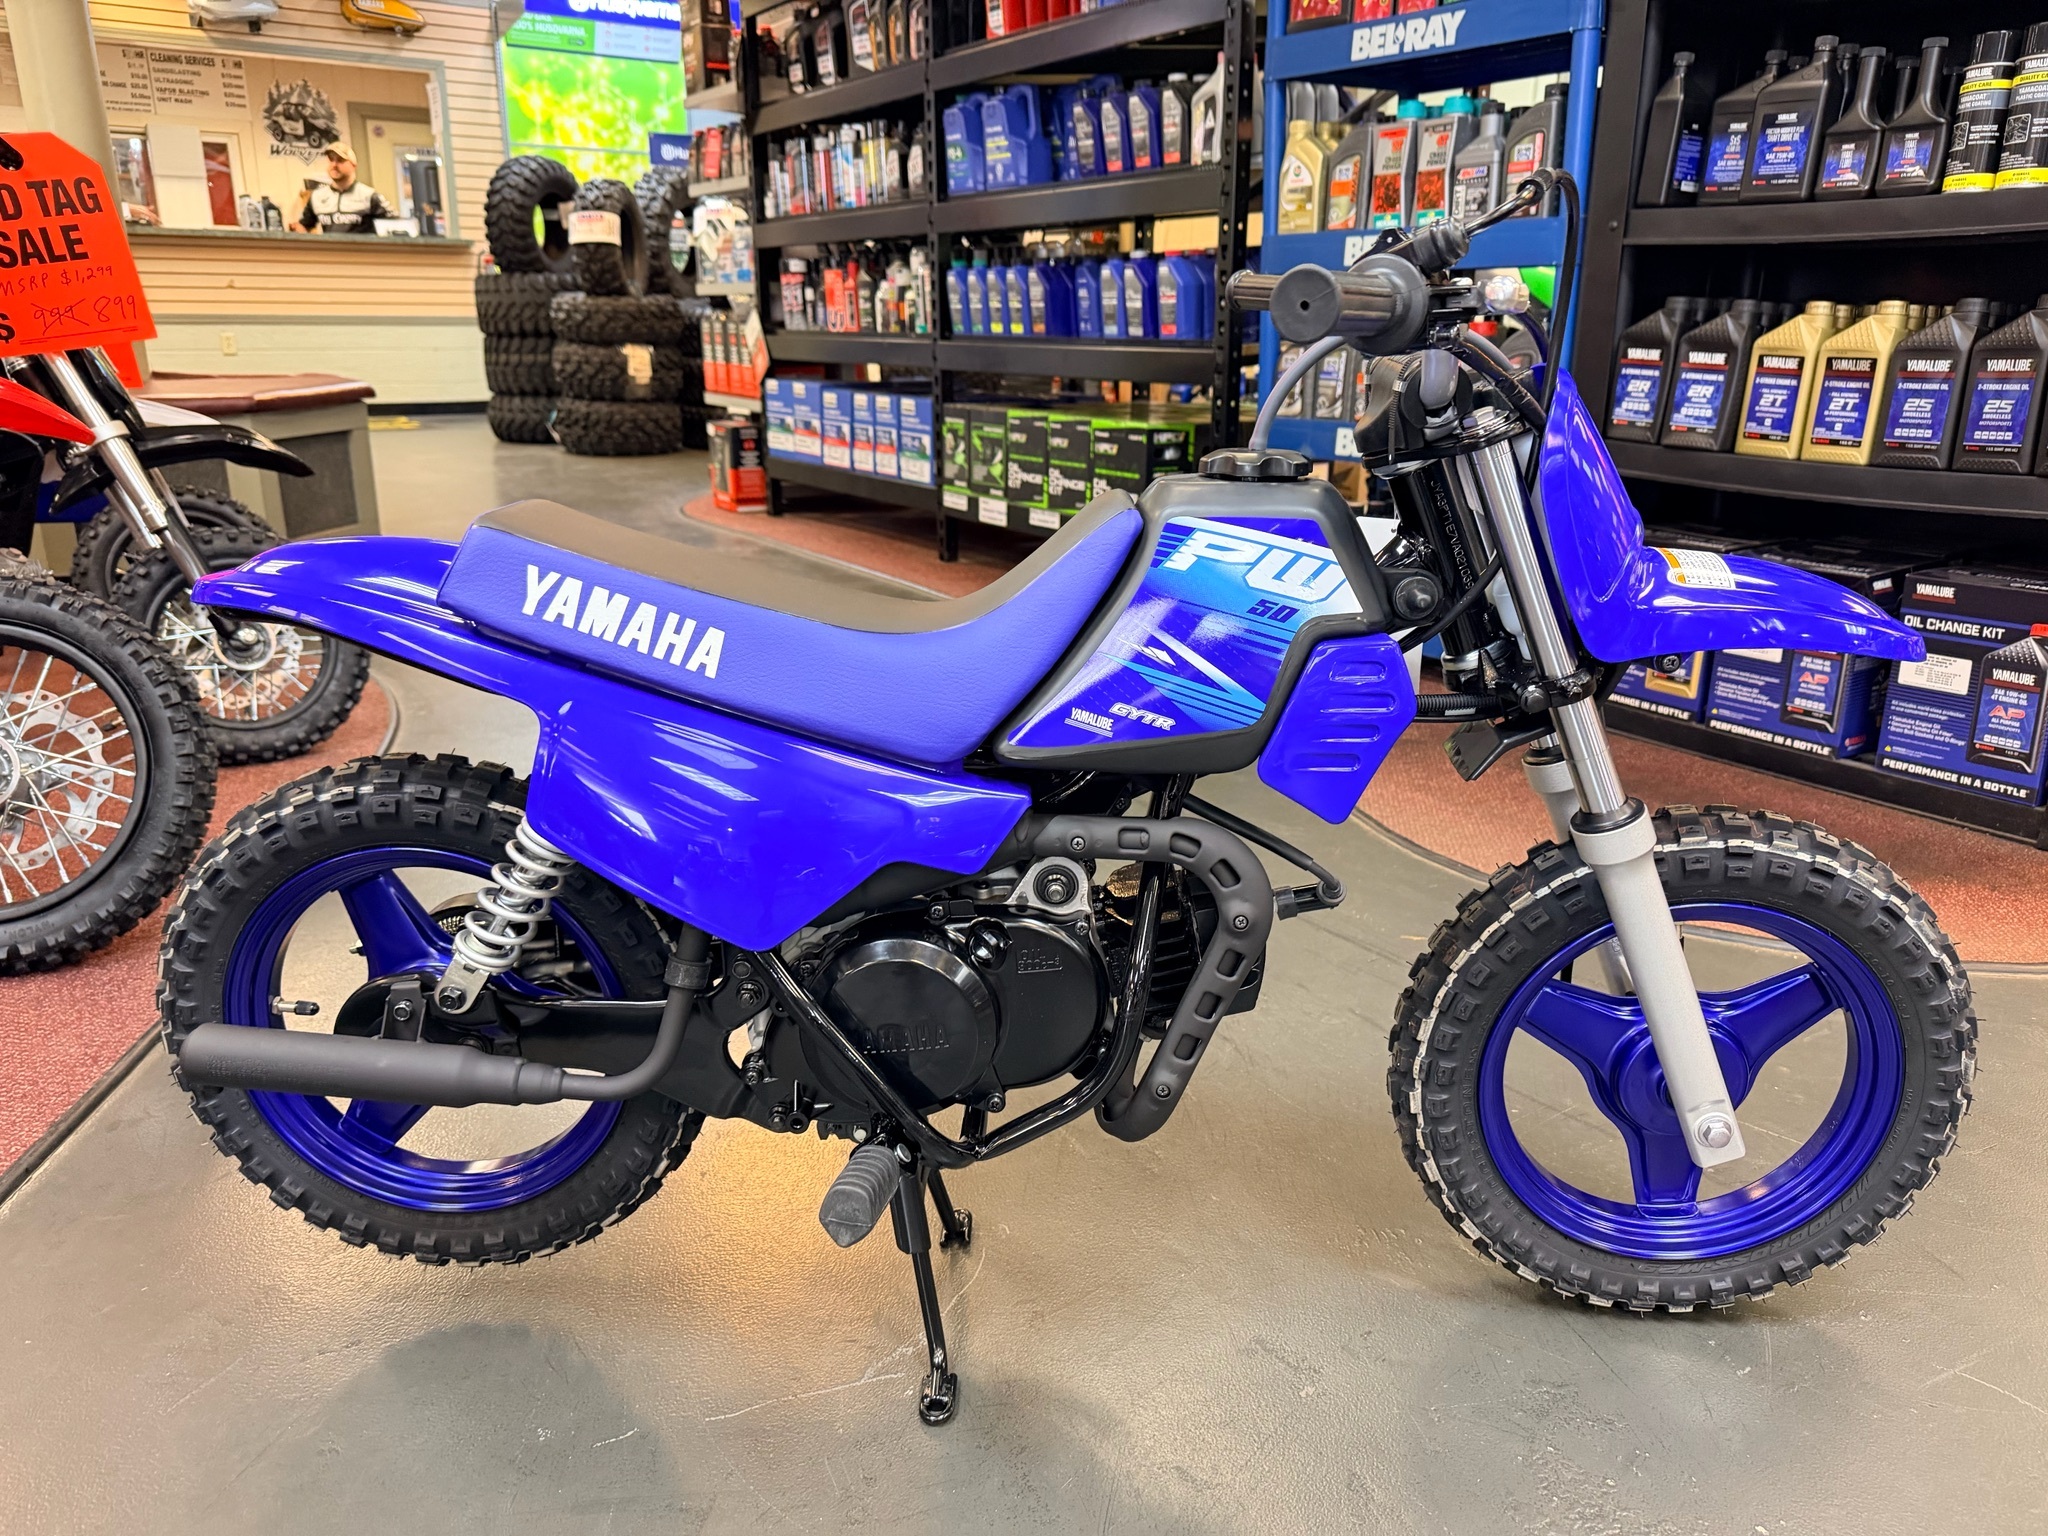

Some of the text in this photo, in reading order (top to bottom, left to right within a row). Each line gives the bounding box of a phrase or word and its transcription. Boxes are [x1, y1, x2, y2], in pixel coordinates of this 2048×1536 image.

[150, 52, 183, 65] CLEANING
[184, 55, 216, 68] SERVICES
[1966, 66, 1995, 79] YAMALUBE
[2020, 74, 2039, 82] QUALITY
[156, 86, 177, 95] VAPOR
[2016, 93, 2032, 101] PLASTIC
[157, 96, 172, 104] UNIT
[1972, 99, 1991, 108] COATING
[25, 176, 104, 219] TAG
[0, 223, 90, 269] SALE
[60, 264, 114, 287] $1,299
[93, 295, 138, 323] 899
[1628, 348, 1661, 361] YAMALUBE
[1689, 351, 1726, 365] YAMALUBE
[1763, 356, 1799, 369] YAMALUBE
[1832, 358, 1872, 372] YAMALUBE
[1907, 359, 1951, 371] YAMALUBE
[1987, 359, 2031, 371] YAMALUBE
[1627, 379, 1652, 393] 2R
[1687, 384, 1714, 398] 2R
[1824, 380, 1846, 388] 2-STROKE
[1847, 381, 1862, 389] ENGINE
[1898, 382, 1949, 391] 2-STROKE ENGINE OIL
[1978, 383, 2002, 391] 2-STROKE
[1759, 394, 1788, 407] 2T
[1828, 397, 1859, 411] 2T
[1162, 527, 1349, 604] PW
[1916, 583, 1956, 599] YAMALUBE
[1245, 598, 1301, 624] 50
[522, 563, 726, 680] YAMAHA
[1904, 614, 2006, 640] OIL CHANGE KIT
[1799, 671, 1829, 685] AP
[1992, 668, 2036, 686] YAMALUBE
[1994, 688, 2027, 700] SAE 10W-40
[1998, 695, 2018, 704] ENGINE
[1641, 699, 1690, 721] IN A BOTTLE
[1899, 701, 1917, 709] includes
[1917, 704, 1942, 714] world-class
[1988, 705, 2026, 720] AP
[1069, 706, 1114, 731] YAMALUBE
[1108, 702, 1178, 731] GYTR
[1892, 716, 1915, 724] Yamalube
[1915, 720, 1932, 728] Engine
[1999, 717, 2020, 727] PURPOSE
[1891, 720, 1911, 729] Genuine
[1912, 725, 1930, 733] Yamaha
[1710, 719, 1830, 756] PERFORMANCE IN A BOTTLE
[1914, 731, 1934, 739] Gaskets
[1882, 758, 2028, 798] PERFORMANCE IN A BOTTLE
[862, 1023, 951, 1055] AMAHA
